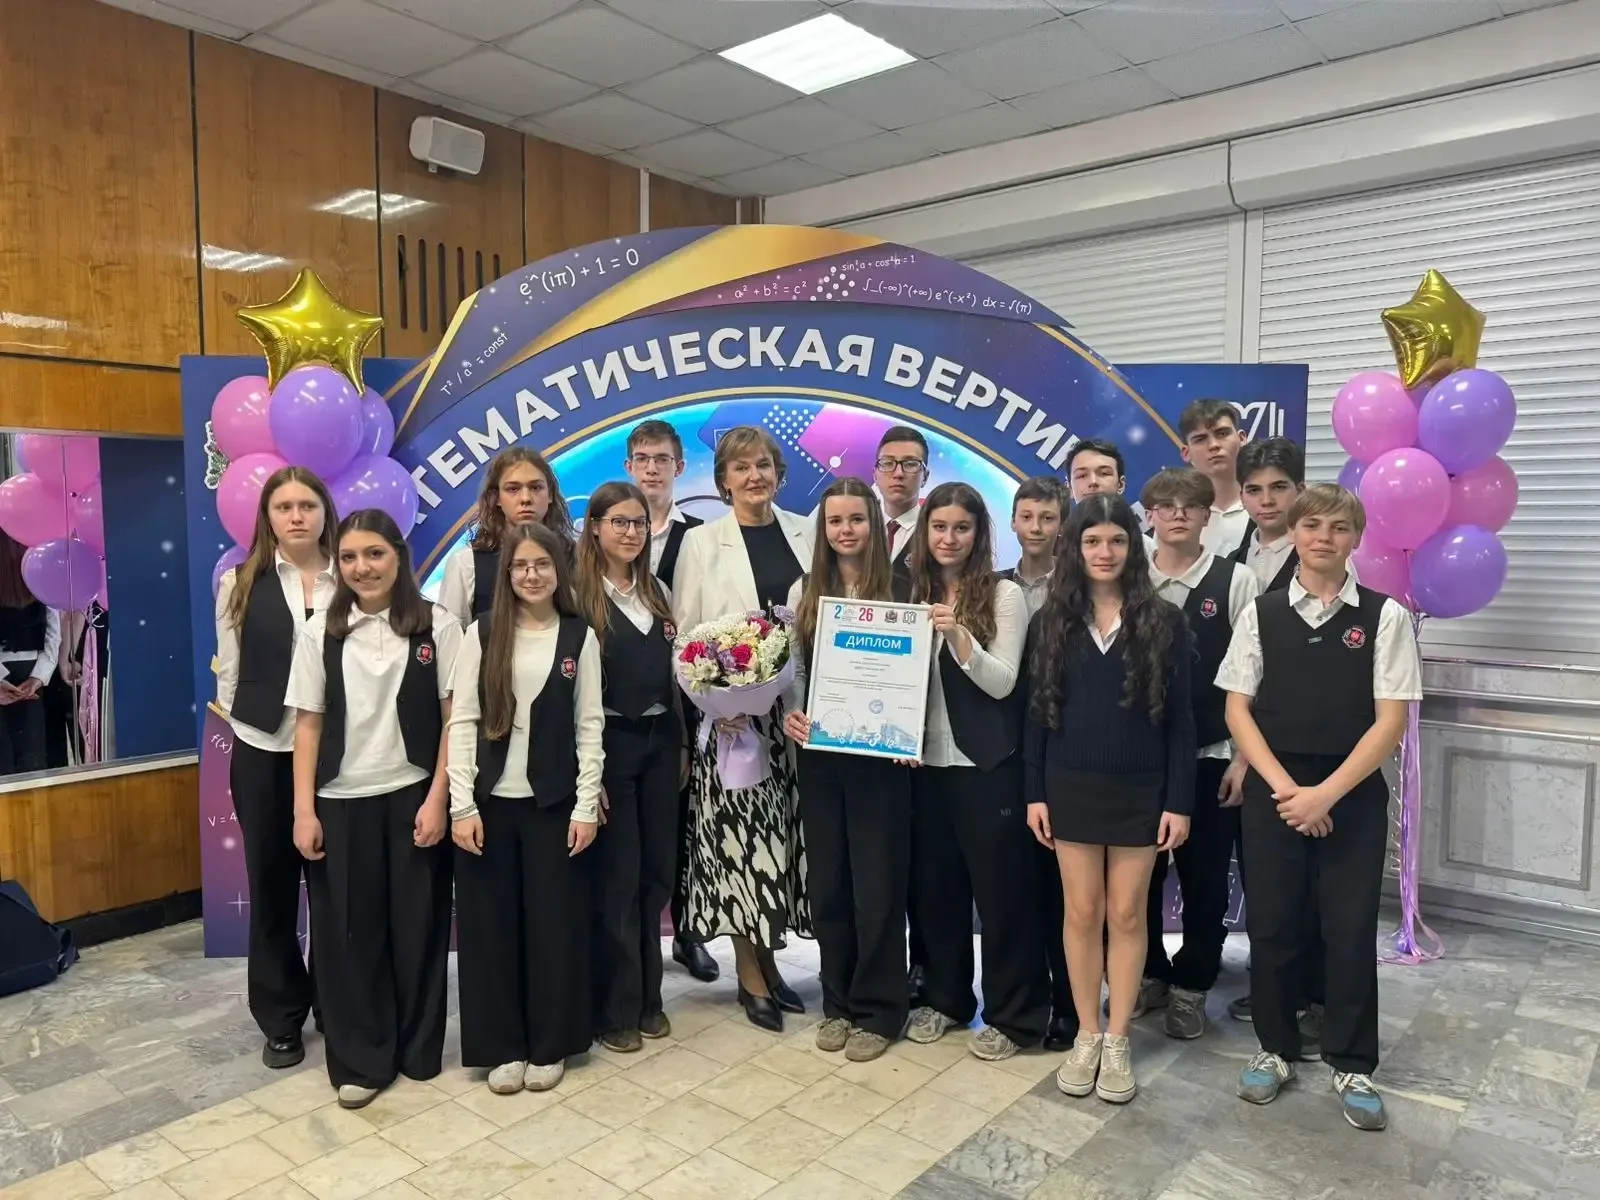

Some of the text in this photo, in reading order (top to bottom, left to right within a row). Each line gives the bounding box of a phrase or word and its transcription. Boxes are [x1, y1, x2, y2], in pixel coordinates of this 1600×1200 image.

[595, 256, 606, 275] 1
[983, 297, 997, 308] dx
[483, 332, 508, 358] const
[410, 326, 875, 525] ТЕМАТИЧЕСКАЯ
[845, 635, 902, 649] ДИПЛОМ
